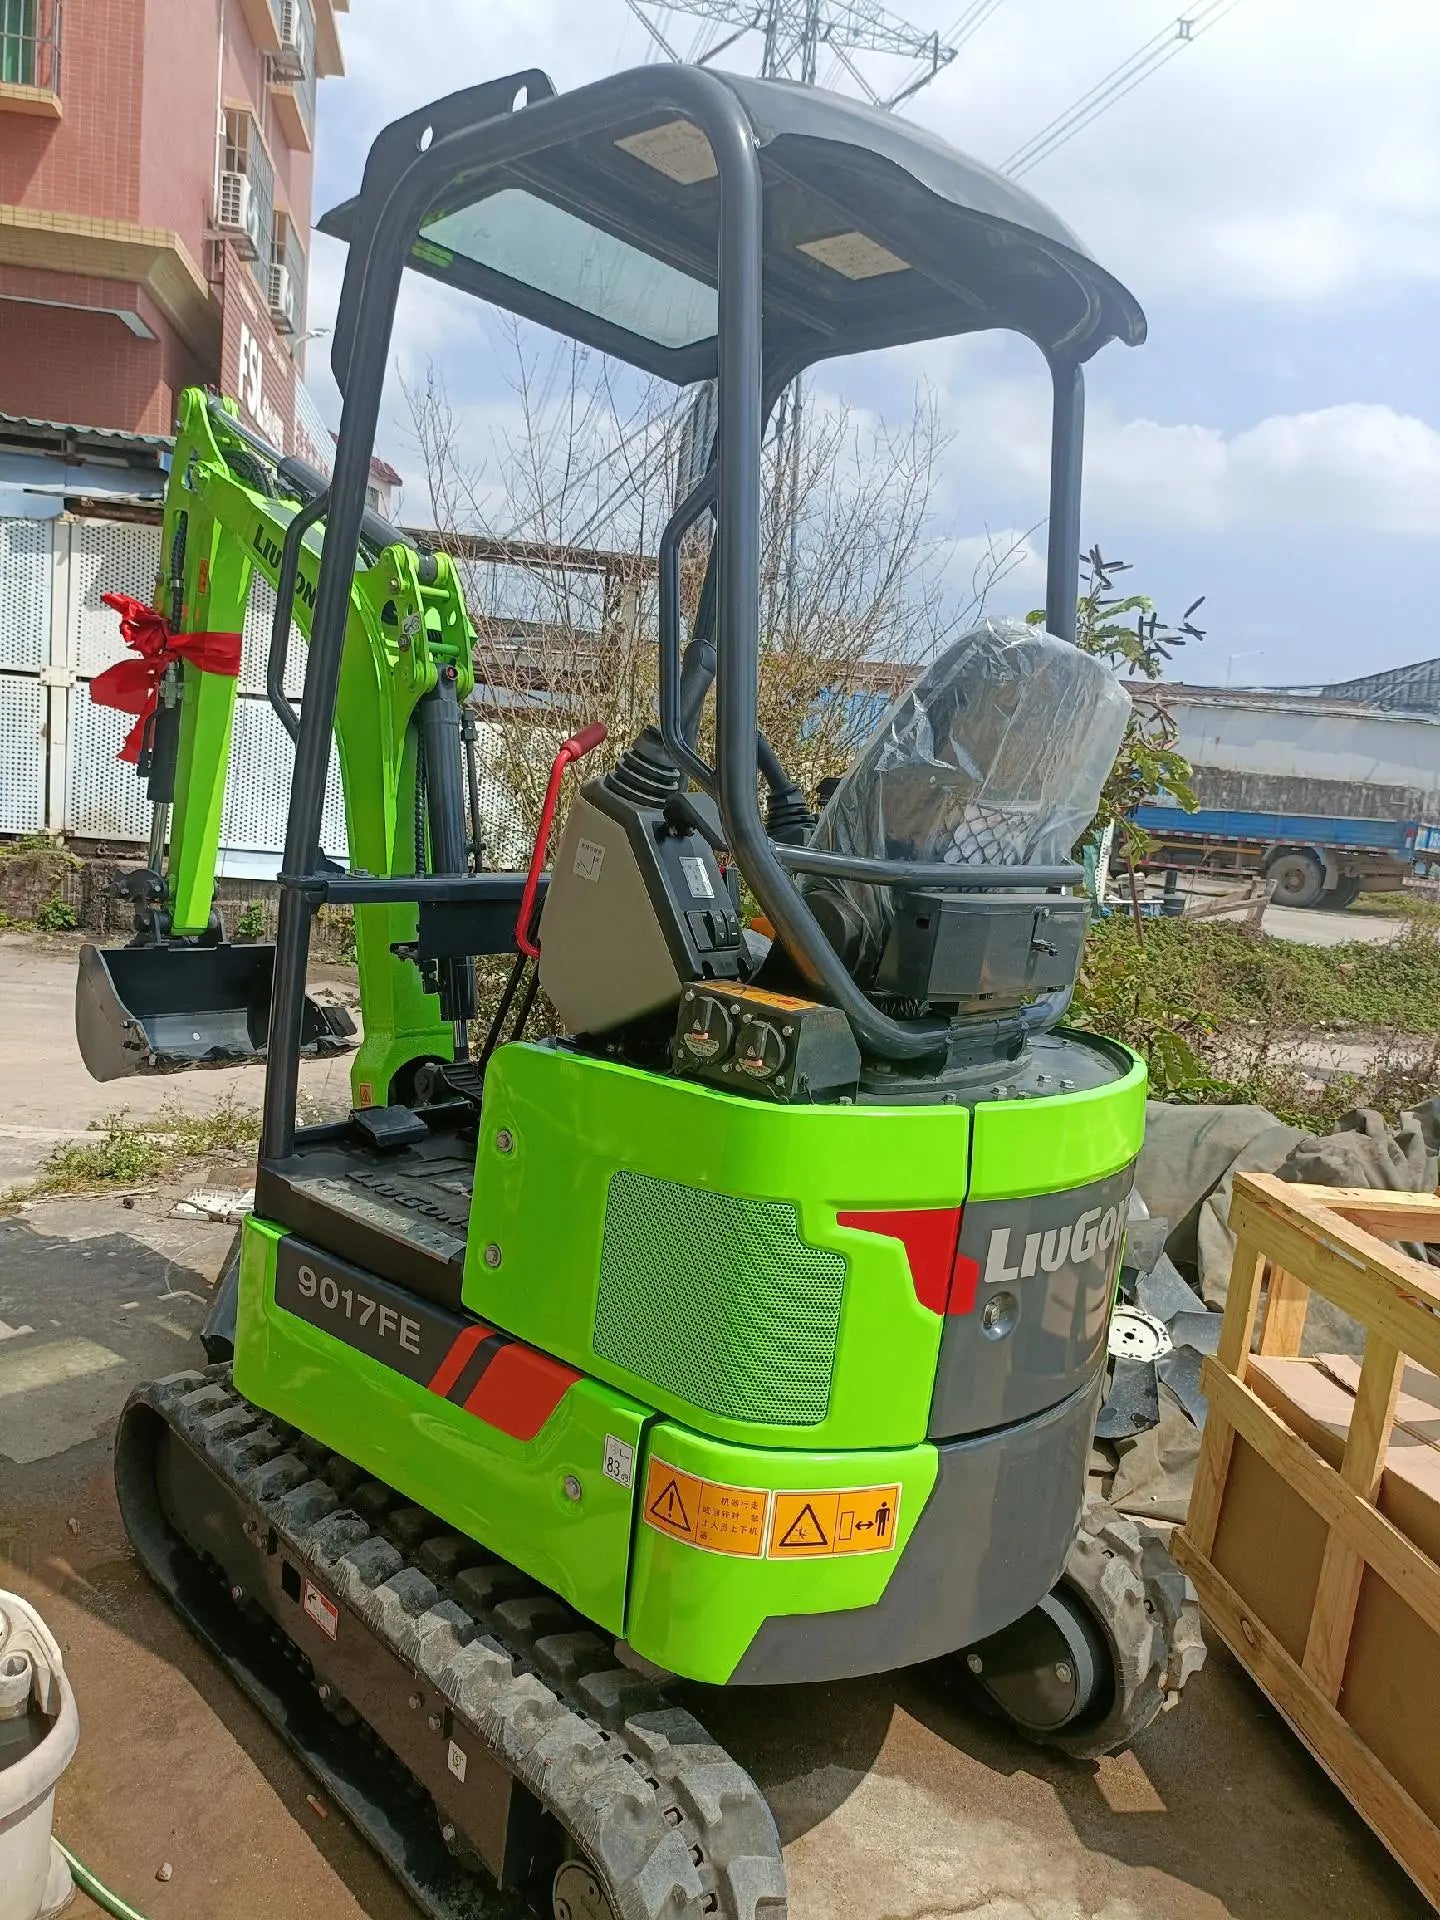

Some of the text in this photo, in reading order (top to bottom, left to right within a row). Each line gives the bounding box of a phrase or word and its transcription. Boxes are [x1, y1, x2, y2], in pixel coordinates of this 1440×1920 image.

[238, 321, 264, 429] FSL
[298, 1265, 420, 1355] 9017FE
[606, 1456, 620, 1477] 83
